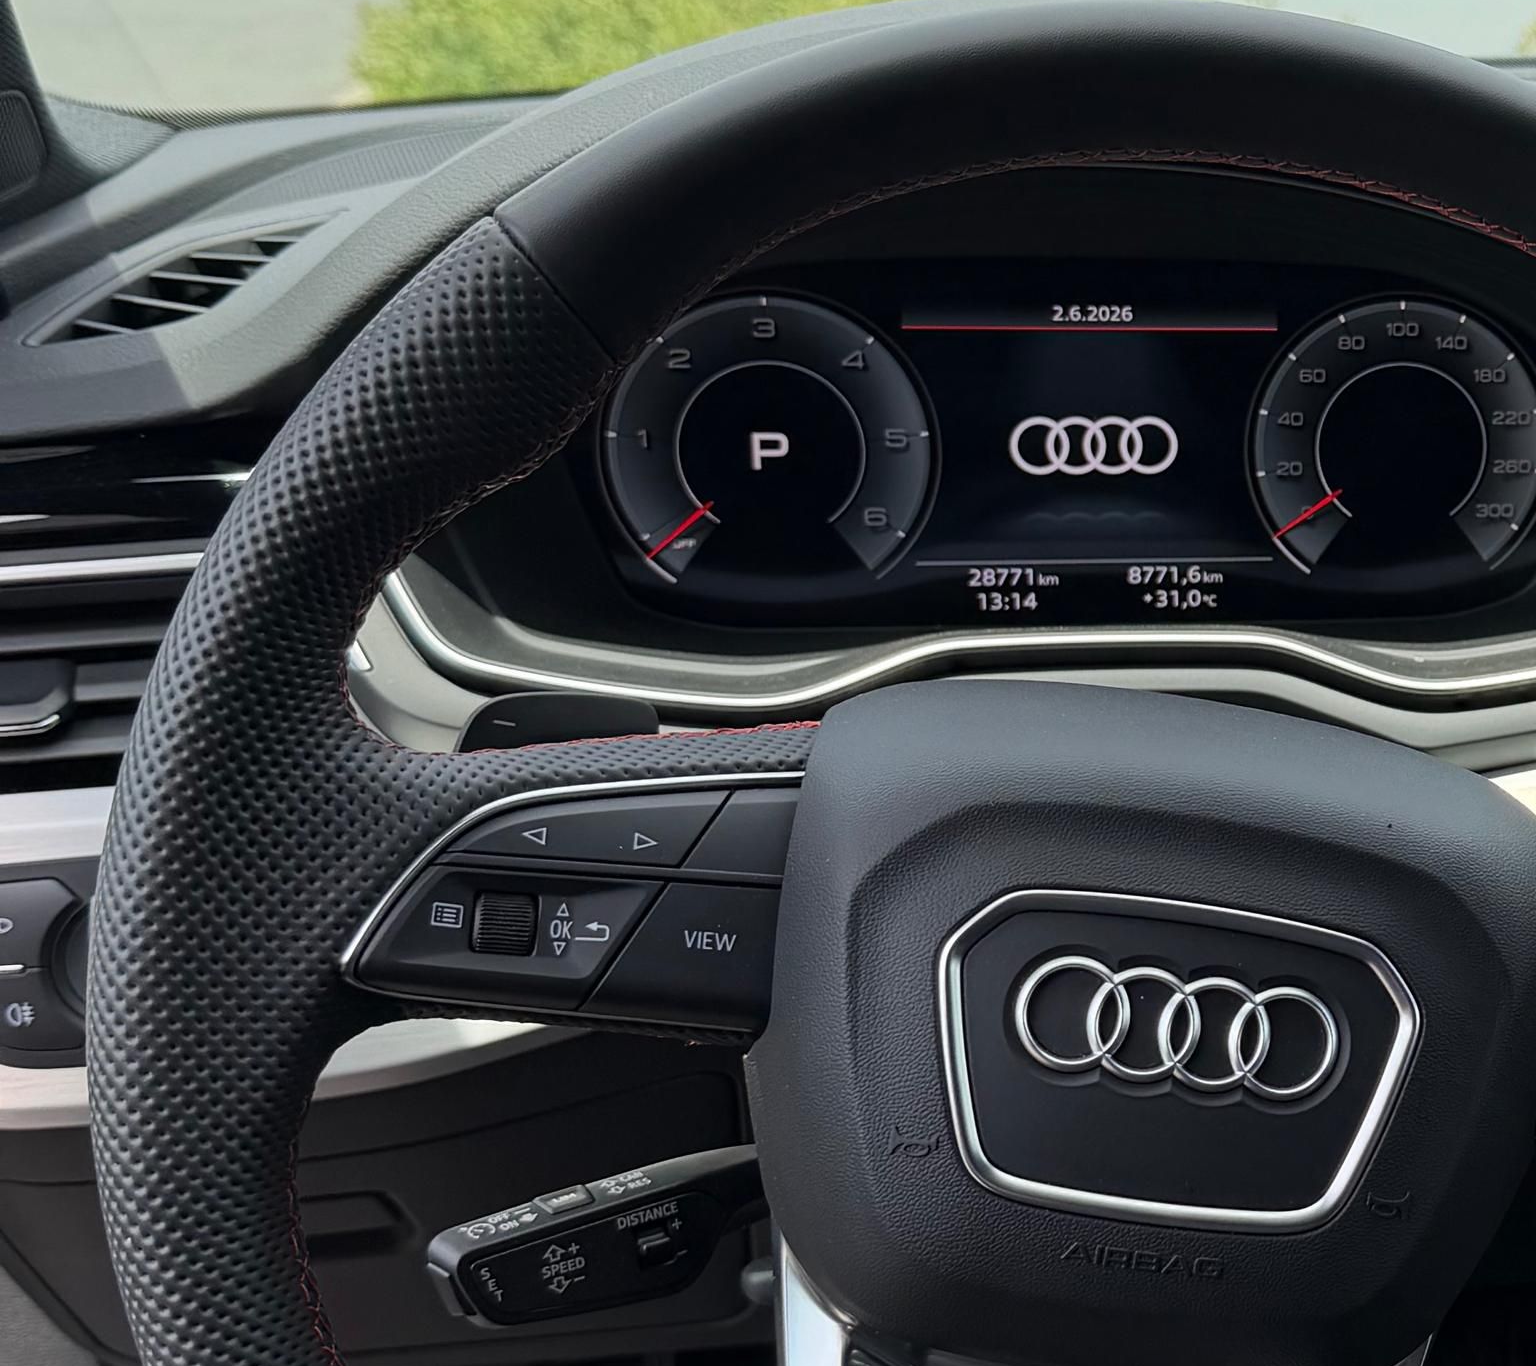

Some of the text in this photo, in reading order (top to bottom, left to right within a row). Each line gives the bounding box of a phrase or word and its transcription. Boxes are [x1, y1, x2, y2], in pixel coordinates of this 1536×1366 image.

[1051, 304, 1134, 322] 2.6.2026
[752, 318, 776, 338] 3
[1386, 323, 1419, 337] 100
[1337, 336, 1365, 350] 80
[1436, 336, 1467, 350] 140
[668, 349, 691, 369] 2
[841, 350, 864, 370] 4
[1299, 368, 1326, 383] 60
[1473, 368, 1506, 383] 180
[1278, 412, 1303, 426] 40
[1492, 411, 1531, 426] 220
[638, 430, 648, 449] 1
[885, 429, 907, 448] 5
[750, 432, 789, 470] P
[1276, 462, 1302, 476] 20
[1492, 460, 1532, 474] 260
[863, 507, 887, 527] 6
[1475, 503, 1514, 519] 300
[967, 568, 1034, 586] 28771
[977, 592, 1038, 611] 13:14
[550, 920, 573, 940] OK
[684, 930, 737, 952] VIEW
[617, 1201, 679, 1230] DISTANCE
[499, 1220, 519, 1232] ON
[542, 1256, 586, 1280] SPEED
[1060, 1242, 1222, 1277] AIRBAG
[480, 1267, 504, 1302] SET
